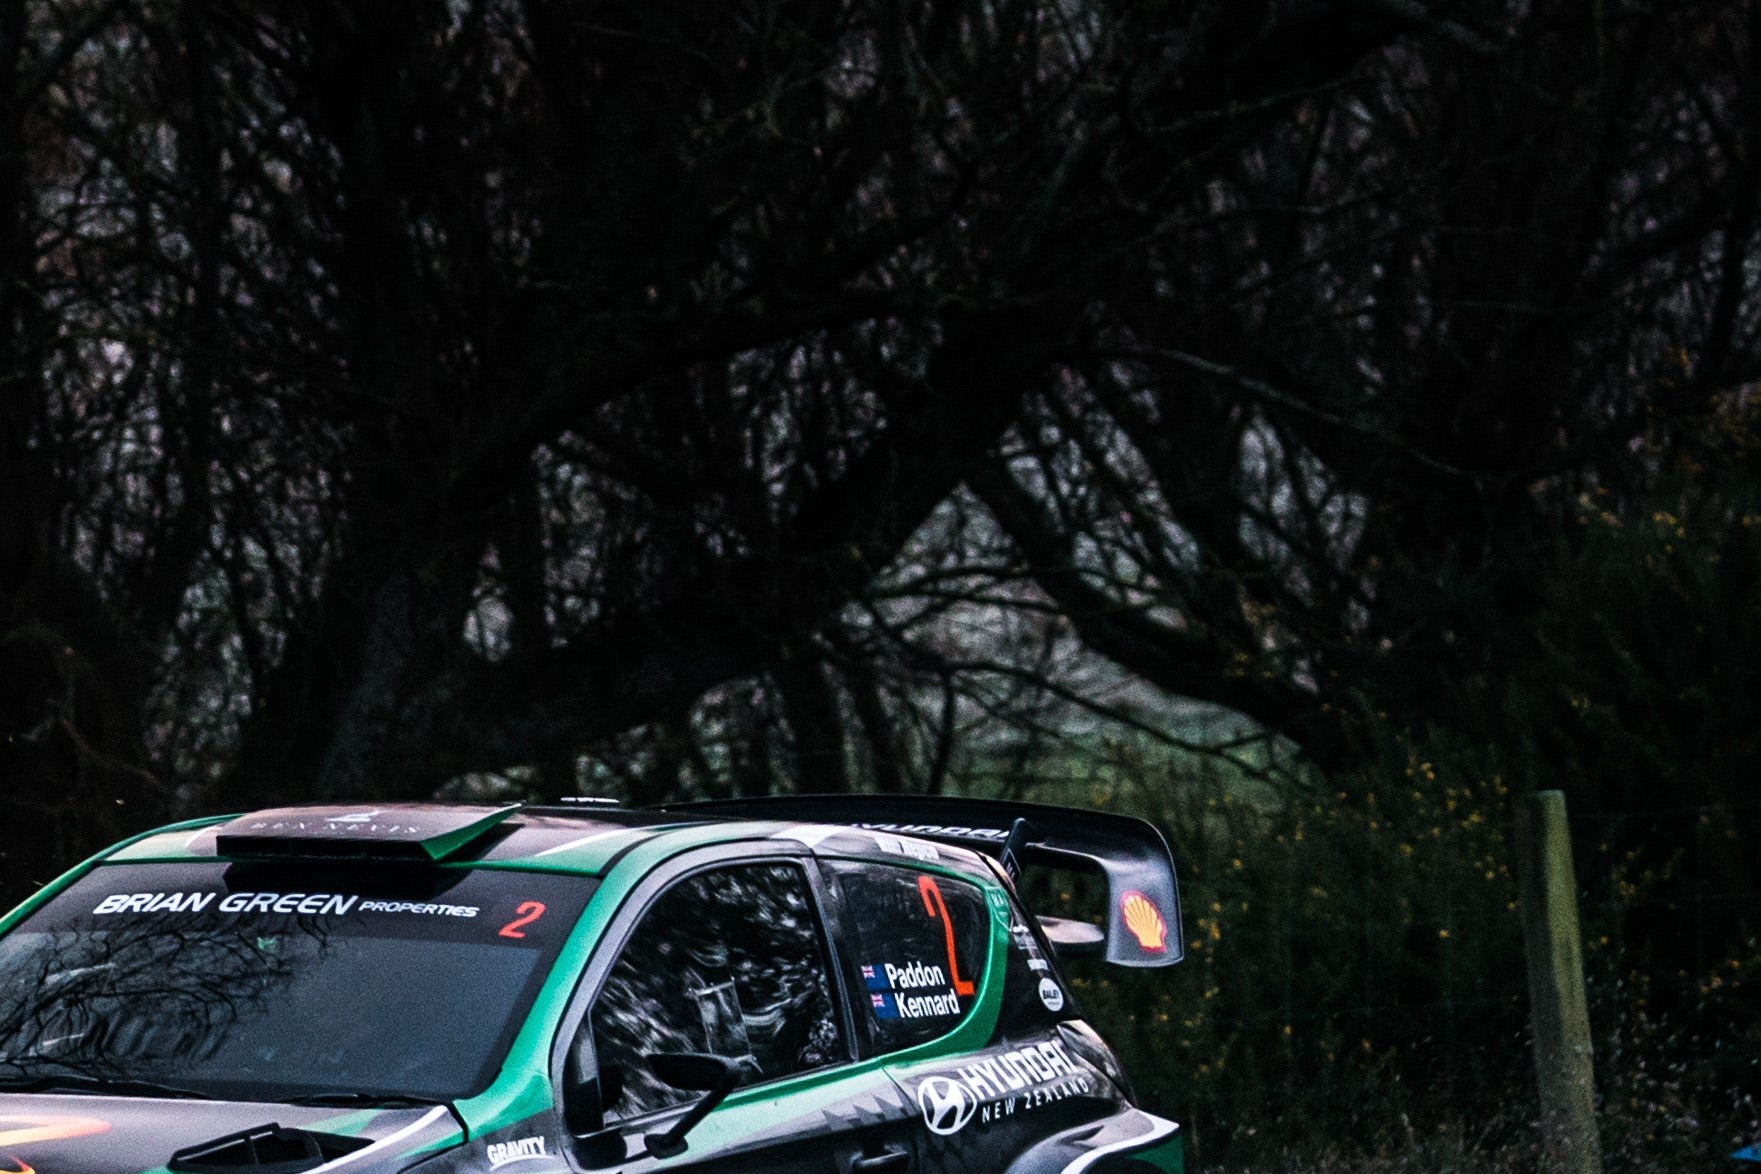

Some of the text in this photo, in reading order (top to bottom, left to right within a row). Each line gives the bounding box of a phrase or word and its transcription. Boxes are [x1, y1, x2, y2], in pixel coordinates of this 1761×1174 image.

[93, 892, 480, 918] BRIAN GREEN PROPERTIES
[498, 901, 546, 938] 2
[917, 875, 975, 996] 2
[884, 961, 946, 990] Paddon
[894, 991, 961, 1019] Kennard
[956, 1039, 1080, 1100] HYUNDAI
[981, 1077, 1090, 1124] NEW ZEALAND
[487, 1135, 546, 1166] GRAVITY
